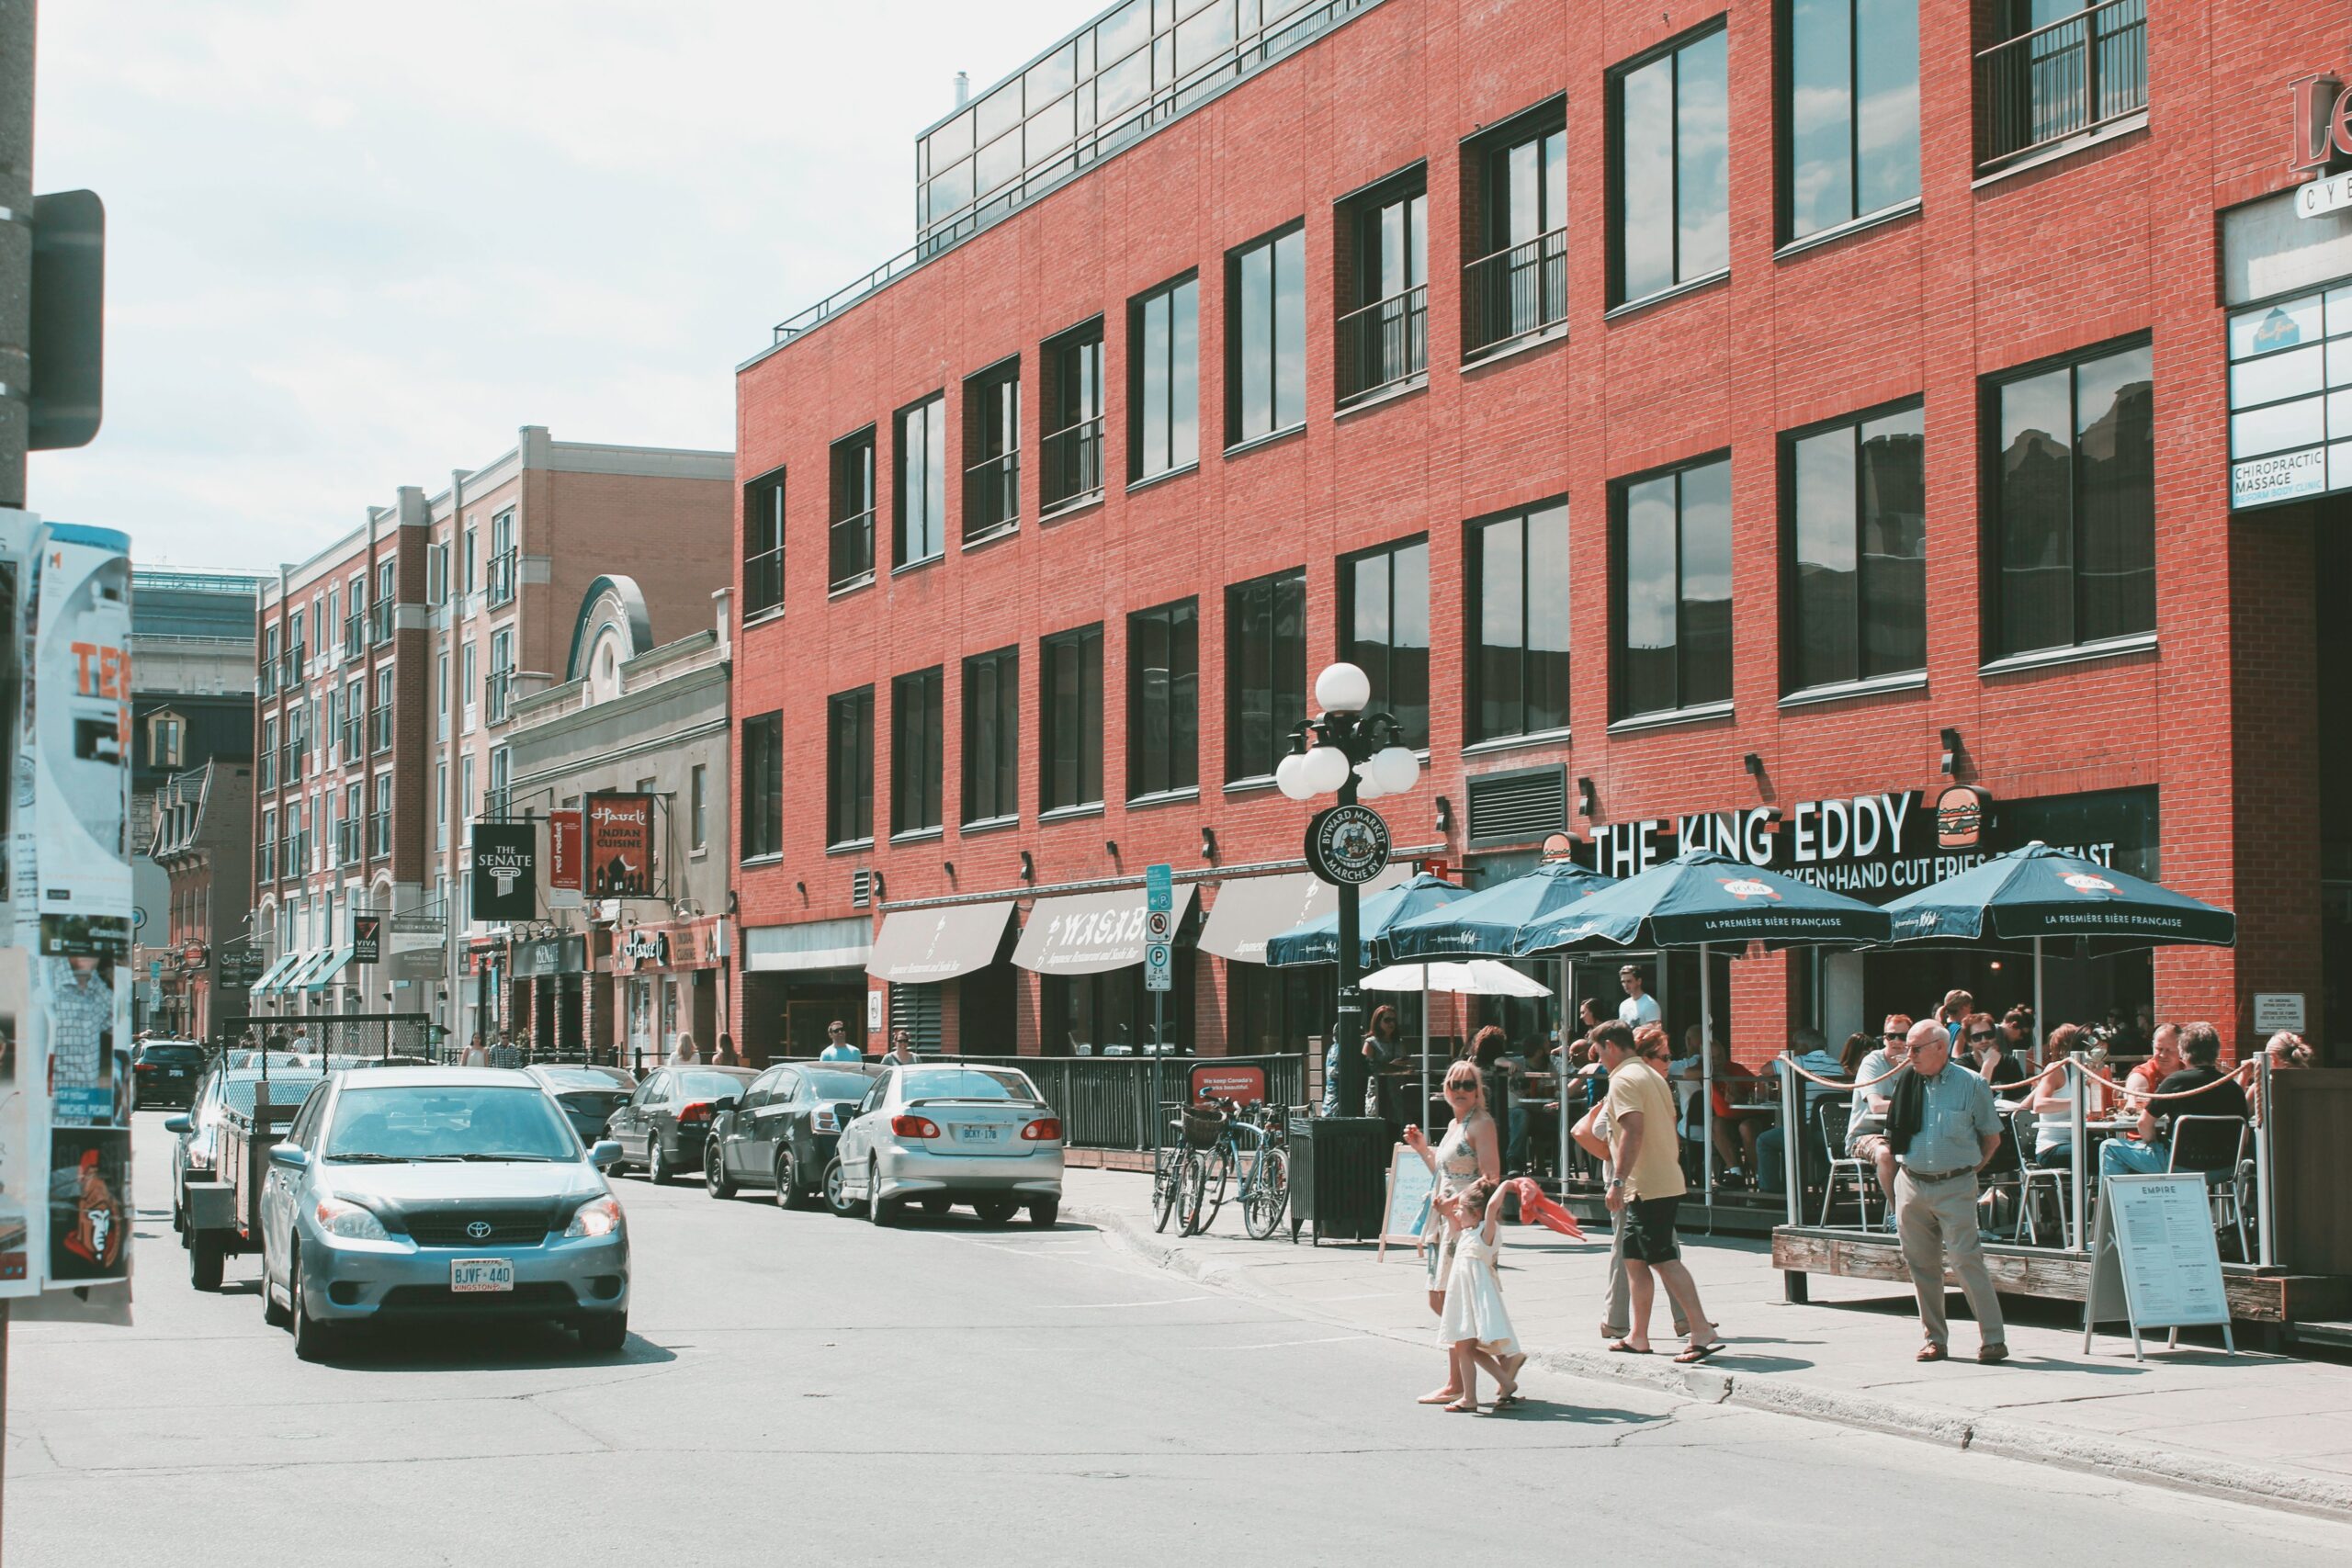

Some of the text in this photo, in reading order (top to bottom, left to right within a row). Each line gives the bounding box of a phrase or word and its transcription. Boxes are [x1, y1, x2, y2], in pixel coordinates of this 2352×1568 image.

[2235, 452, 2322, 479] CHIROPRACTIC
[2235, 472, 2291, 493] MASSAGE
[2271, 485, 2294, 498] BODY
[2296, 479, 2322, 492] CLINIC
[591, 807, 647, 826] Haveli
[599, 829, 640, 837] INDIAN
[1322, 809, 1386, 844] BYWARD MARKET
[1589, 790, 1911, 879] THE KING EDDY
[495, 845, 516, 854] THE
[597, 839, 641, 848] CUISINE
[478, 854, 532, 867] SENATE
[1368, 859, 1380, 874] BY
[1891, 857, 1930, 886] CUT
[1935, 853, 1986, 883] FRIES
[1059, 906, 1147, 946] WASAB
[1705, 920, 1717, 929] LA
[1791, 918, 1841, 928] FRANÇAISE
[2045, 916, 2057, 924] LA
[2132, 915, 2182, 927] FRANÇAISE
[624, 930, 664, 972] Haveli
[2142, 1185, 2177, 1195] EMPIRE
[455, 1268, 510, 1283] BJVF 440
